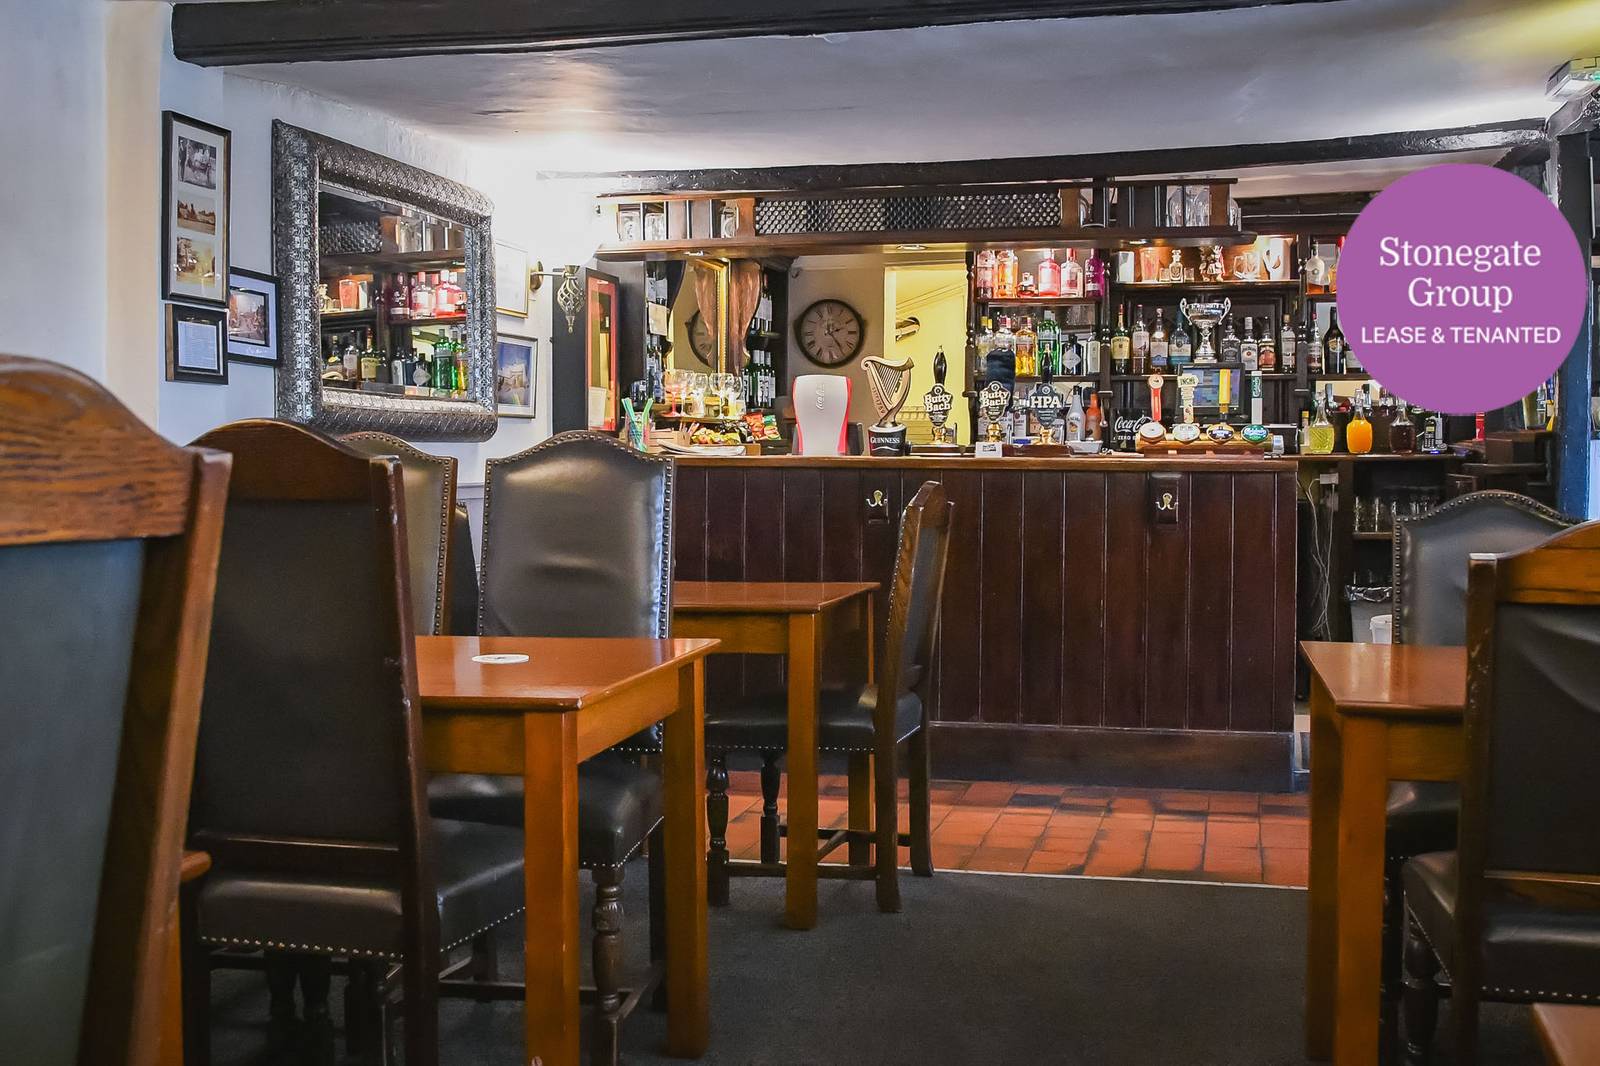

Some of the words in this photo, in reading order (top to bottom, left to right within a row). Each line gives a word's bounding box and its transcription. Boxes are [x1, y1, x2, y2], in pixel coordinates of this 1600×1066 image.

[924, 393, 952, 404] Butty
[981, 390, 1010, 401] Butty
[925, 401, 951, 412] Bach
[981, 398, 1008, 408] Bach
[1030, 396, 1062, 409] HPA
[870, 436, 901, 444] GUINNESS
